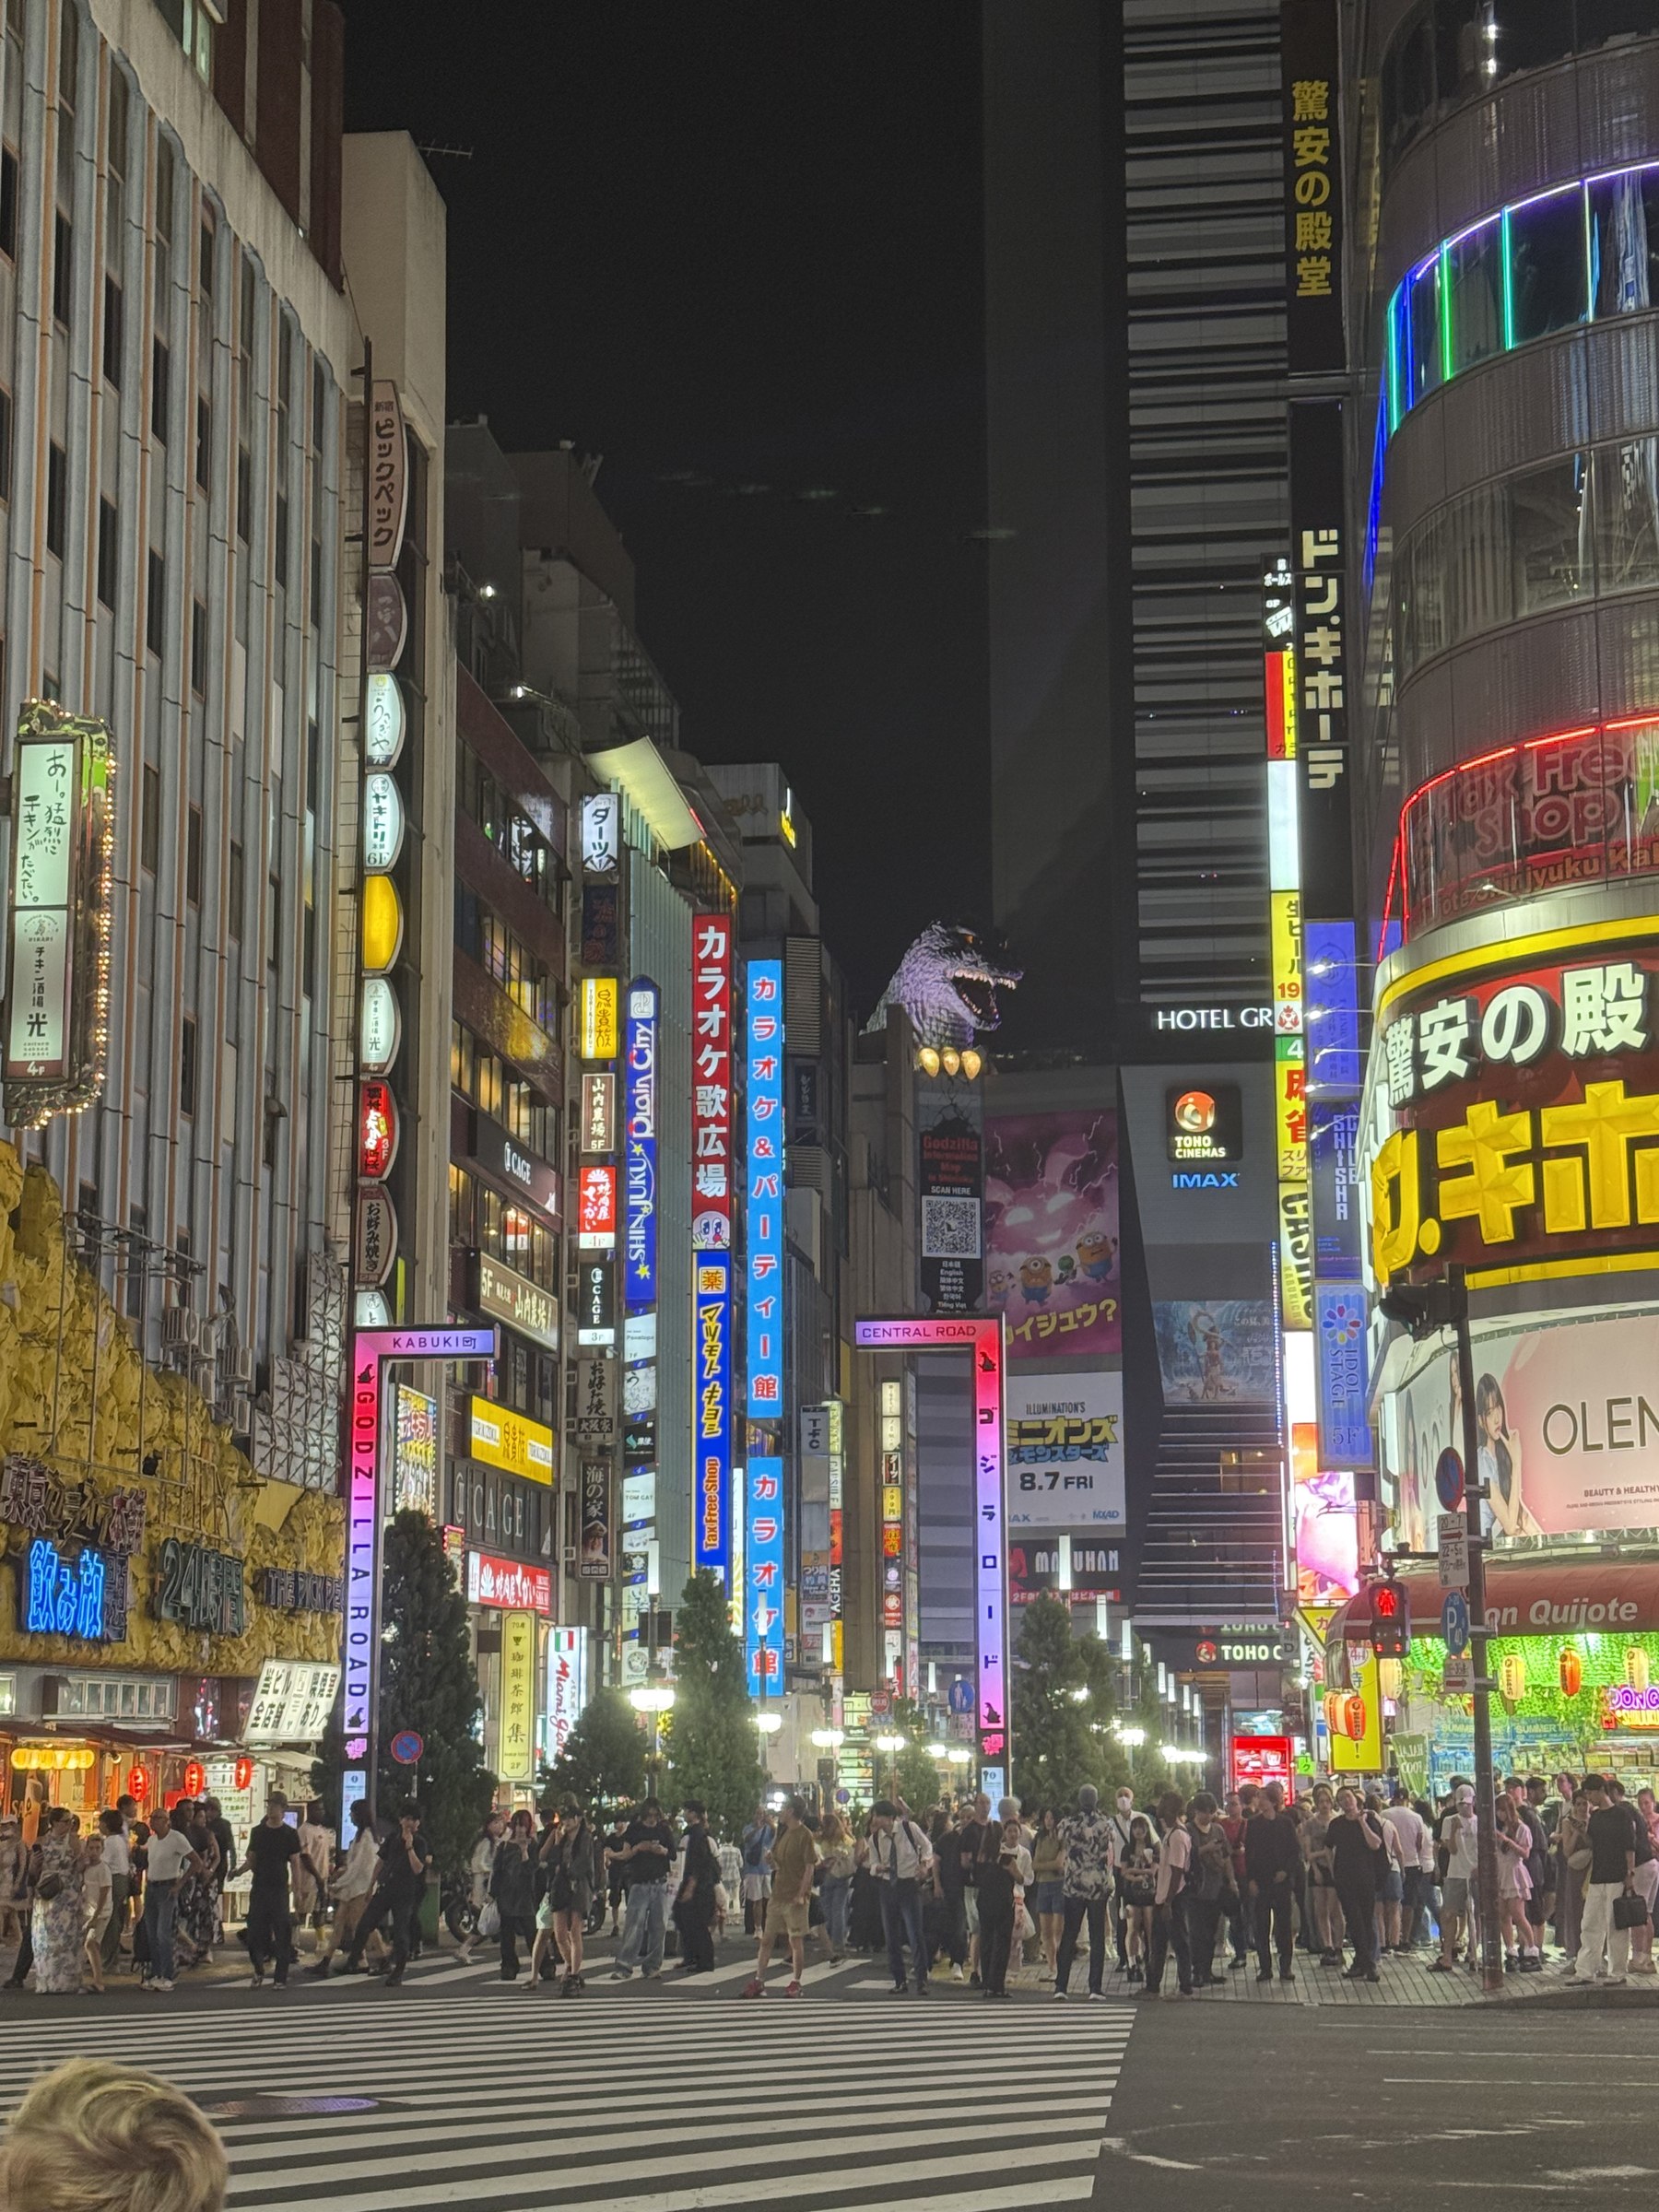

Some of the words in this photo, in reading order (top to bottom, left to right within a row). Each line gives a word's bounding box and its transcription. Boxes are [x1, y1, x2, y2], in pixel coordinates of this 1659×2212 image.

[1291, 79, 1333, 297] 驚安の殿堂
[371, 756, 386, 765] 7F
[592, 806, 611, 858] ダーツ
[367, 853, 390, 865] 6F
[27, 1012, 48, 1038] 光
[1159, 1008, 1235, 1031] HOTEL
[1385, 961, 1646, 1106] 驚安の殿
[26, 1061, 45, 1077] 4F
[695, 925, 728, 1197] カラオケ歌広場
[591, 1139, 606, 1150] 5F
[923, 1135, 978, 1152] Godzilla
[1174, 1136, 1212, 1149] TOHO
[1174, 1147, 1226, 1159] CINEMAS
[511, 1153, 532, 1185] CAGE
[1172, 1172, 1240, 1189] IMAX
[931, 1185, 951, 1194] SCAN
[952, 1186, 971, 1195] HERE
[365, 1201, 382, 1272] お好み焼き
[481, 1266, 493, 1299] 5F
[701, 1269, 724, 1291] 薬
[940, 1268, 964, 1277] English
[592, 1285, 602, 1324] CAGE
[862, 1326, 931, 1338] CENTRAL
[936, 1325, 977, 1336] ROAD
[700, 1300, 725, 1439] マツモトキヨシ
[1330, 1348, 1344, 1409] STAGE
[1345, 1348, 1359, 1397] IDOL
[1026, 1401, 1086, 1416] ILLUMINATION'S
[1006, 1415, 1119, 1446] ミニオンズ
[352, 1390, 376, 1583] GODZILLA
[703, 1457, 720, 1492] Shop
[1019, 1471, 1061, 1491] 8.7
[1064, 1476, 1094, 1490] FRI
[585, 1465, 605, 1519] 海の家
[1583, 1488, 1615, 1498] BEAUTY
[1617, 1487, 1622, 1495] &
[473, 1483, 524, 1538] CAGE
[703, 1493, 720, 1525] Free
[703, 1526, 720, 1550] Tax
[979, 1406, 998, 1669] ゴジラロード
[1035, 1549, 1120, 1573] MAUHAN
[160, 1539, 244, 1637] 24時間
[830, 1568, 841, 1613] AGEHA
[1446, 1606, 1457, 1646] P
[1529, 1595, 1639, 1628] Quijote
[347, 1605, 370, 1698] ROAD
[1220, 1644, 1270, 1661] TOHO
[506, 1722, 527, 1745] 集
